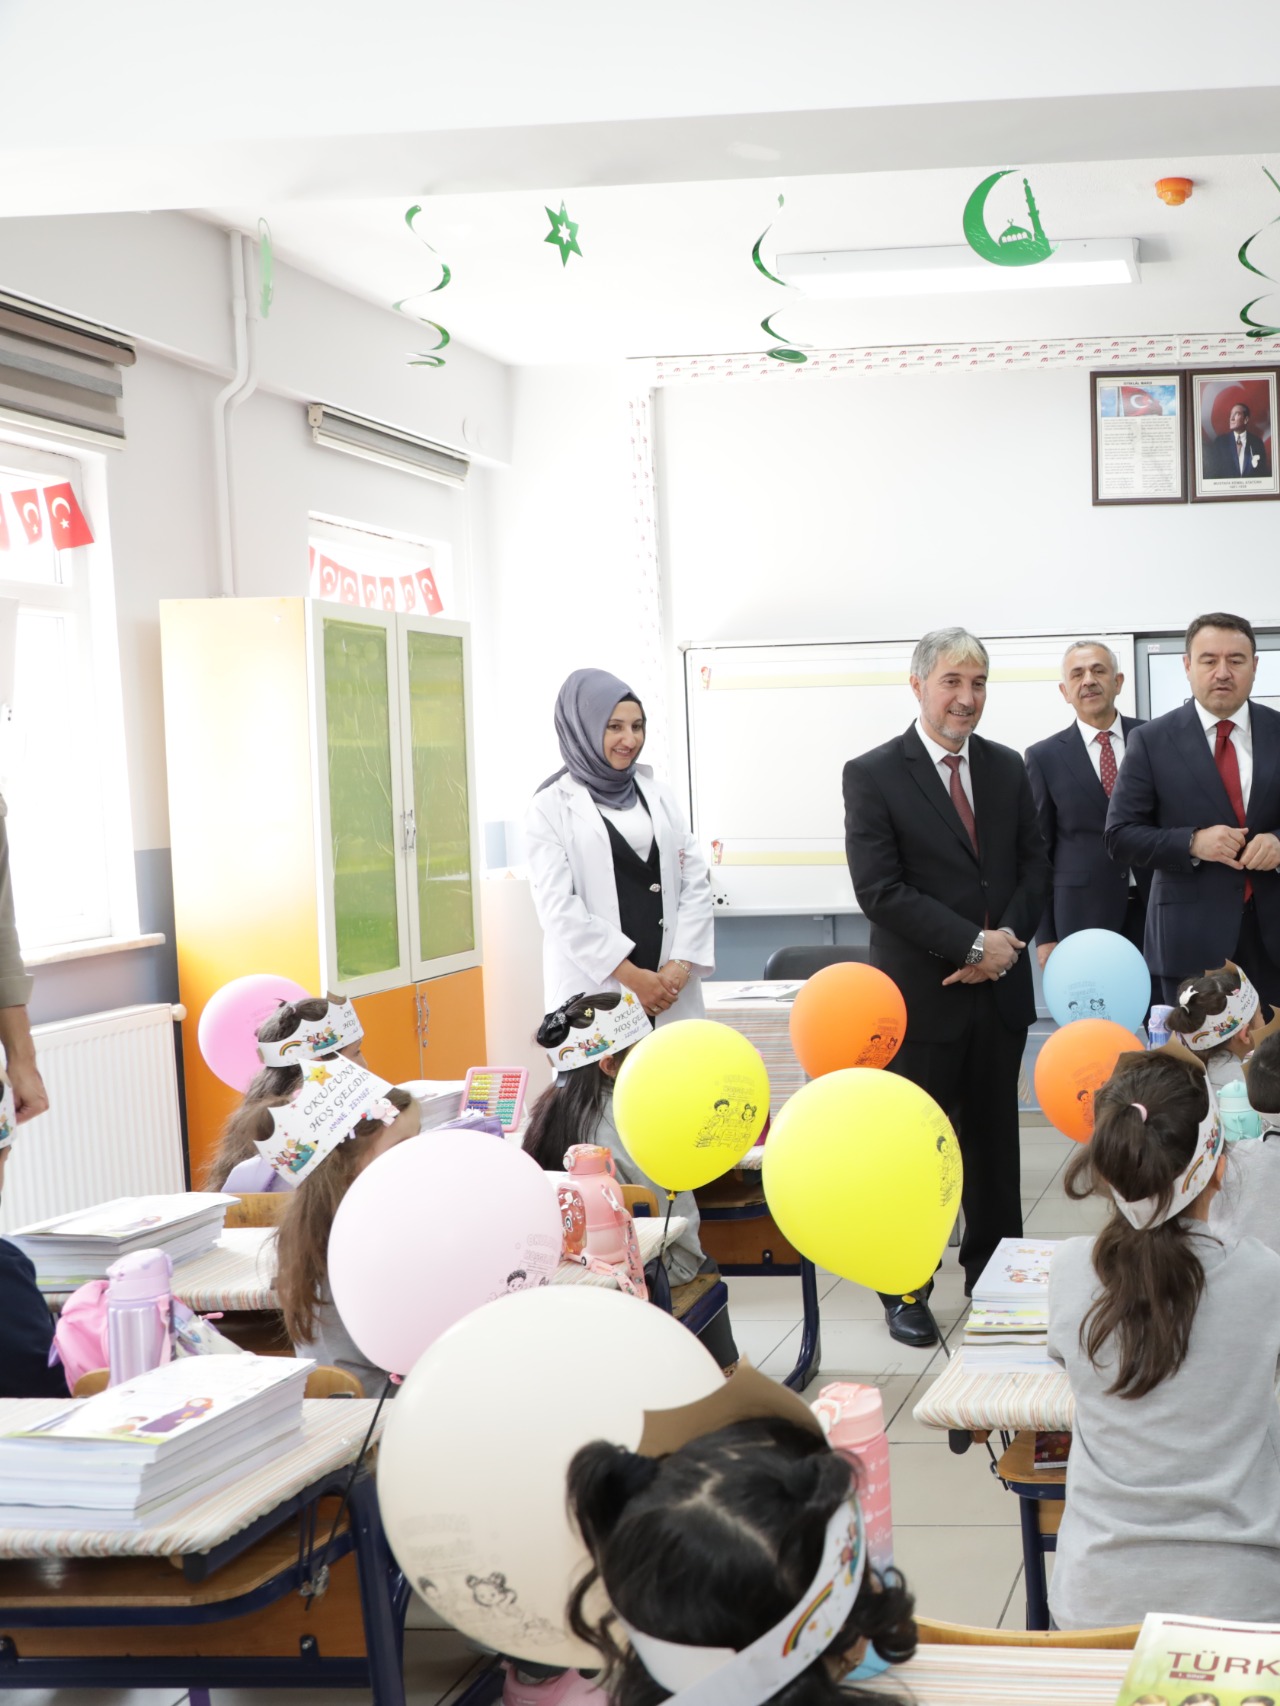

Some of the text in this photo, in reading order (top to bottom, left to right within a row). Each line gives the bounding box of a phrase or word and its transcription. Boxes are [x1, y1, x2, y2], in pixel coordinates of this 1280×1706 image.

[303, 1063, 356, 1116] OKULUNA
[309, 1071, 371, 1133] HOŞ GELDİN
